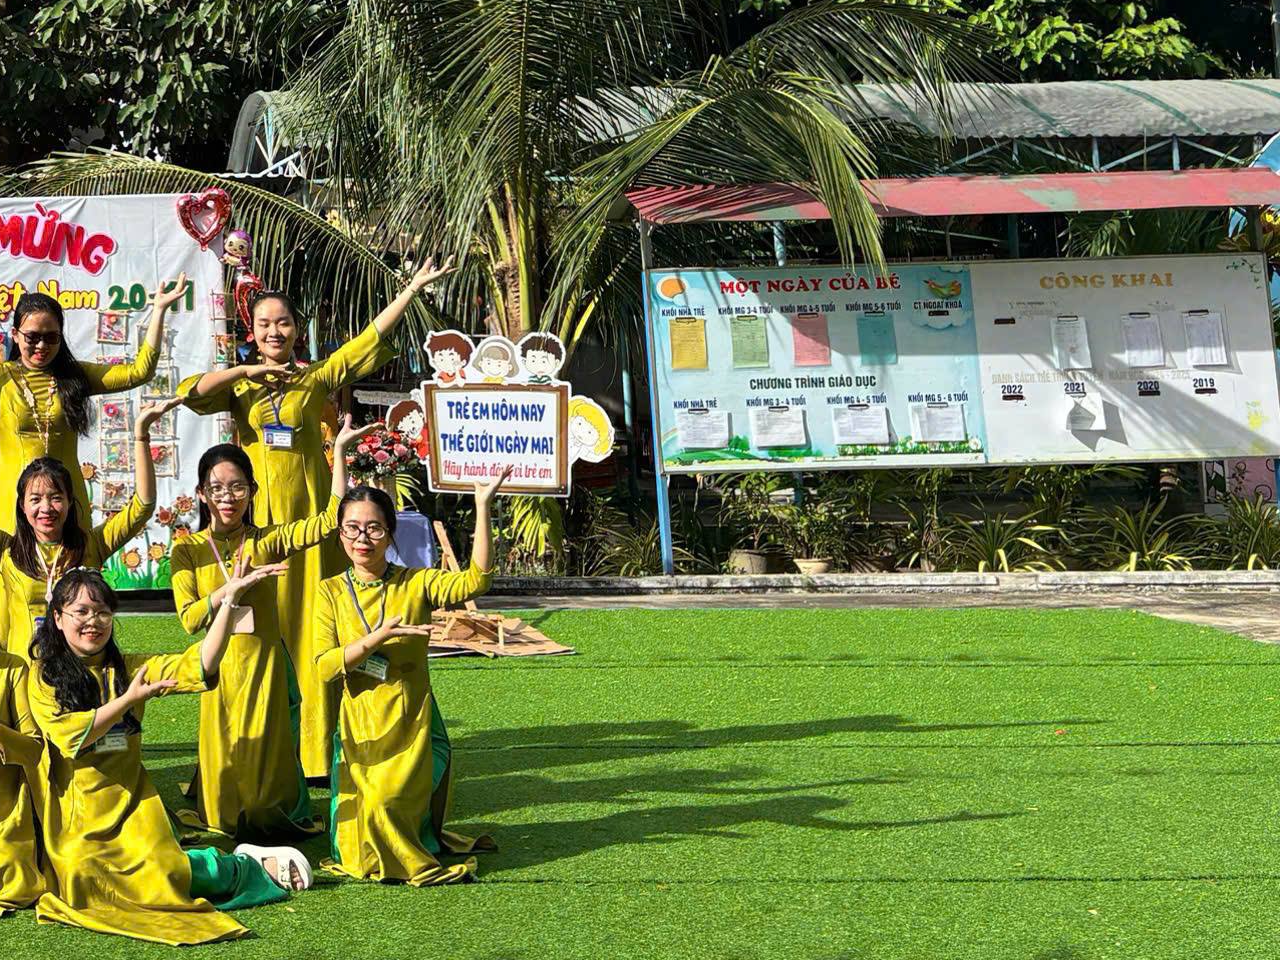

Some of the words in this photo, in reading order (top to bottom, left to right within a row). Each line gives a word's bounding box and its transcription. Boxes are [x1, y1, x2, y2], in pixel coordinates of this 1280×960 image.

[720, 277, 760, 297] MỘT
[767, 276, 822, 292] NGÀY
[828, 273, 871, 290] CỦA
[1040, 271, 1105, 289] CÔNG
[1112, 272, 1174, 288] KHAI
[749, 377, 792, 390] CHƯƠNG
[795, 375, 825, 389] TRÌNH
[828, 373, 853, 388] GIÁO
[855, 375, 877, 390] DỤC
[1001, 384, 1023, 394] 2022
[1063, 382, 1086, 392] 2021
[1137, 380, 1160, 391] 2020
[1193, 378, 1215, 388] 2019
[446, 395, 470, 420] TRẺ
[472, 401, 490, 421] EM
[492, 398, 519, 421] HÔM
[521, 403, 546, 422] NAY
[440, 425, 465, 452] THẾ
[466, 429, 494, 453] GIỚI
[495, 430, 529, 454] NGÀY
[531, 436, 554, 455] MAI
[443, 460, 462, 480] Hãy
[464, 461, 488, 477] hành
[538, 467, 553, 479] em
